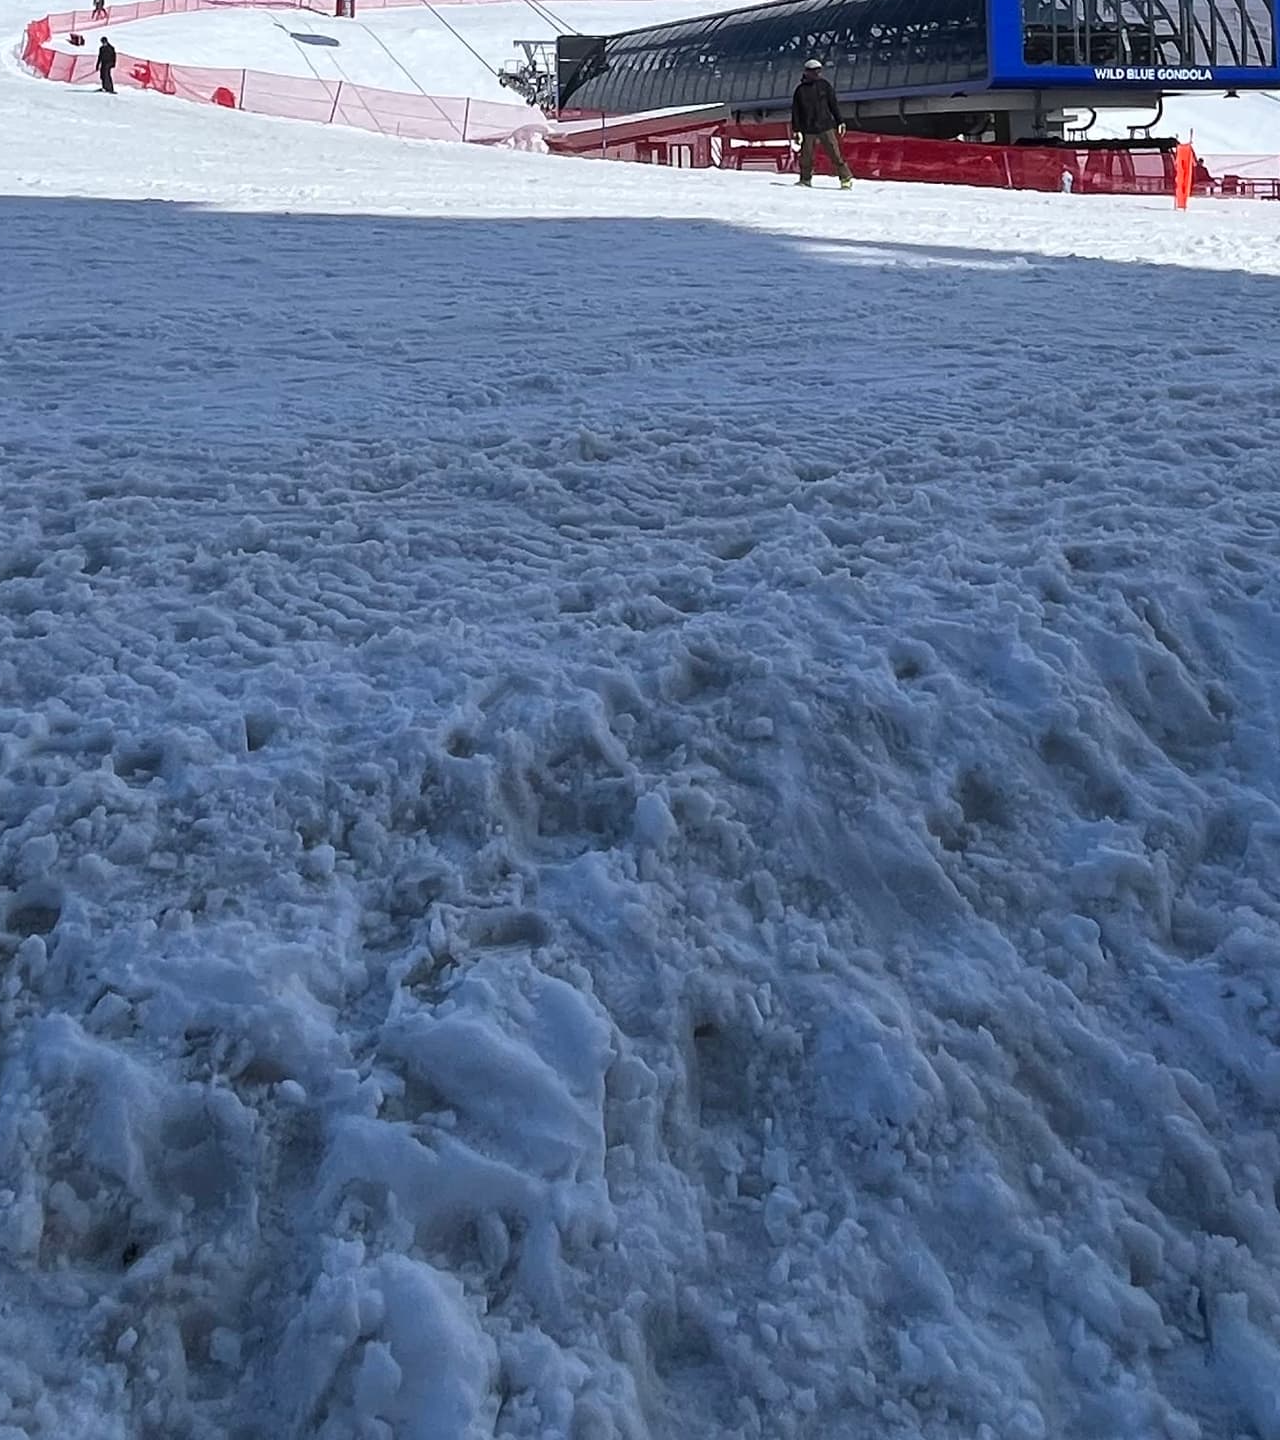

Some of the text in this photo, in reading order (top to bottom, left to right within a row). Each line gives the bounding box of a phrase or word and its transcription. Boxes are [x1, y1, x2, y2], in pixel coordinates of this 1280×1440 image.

[1094, 68, 1213, 81] WILD BLUE GONDOLA
